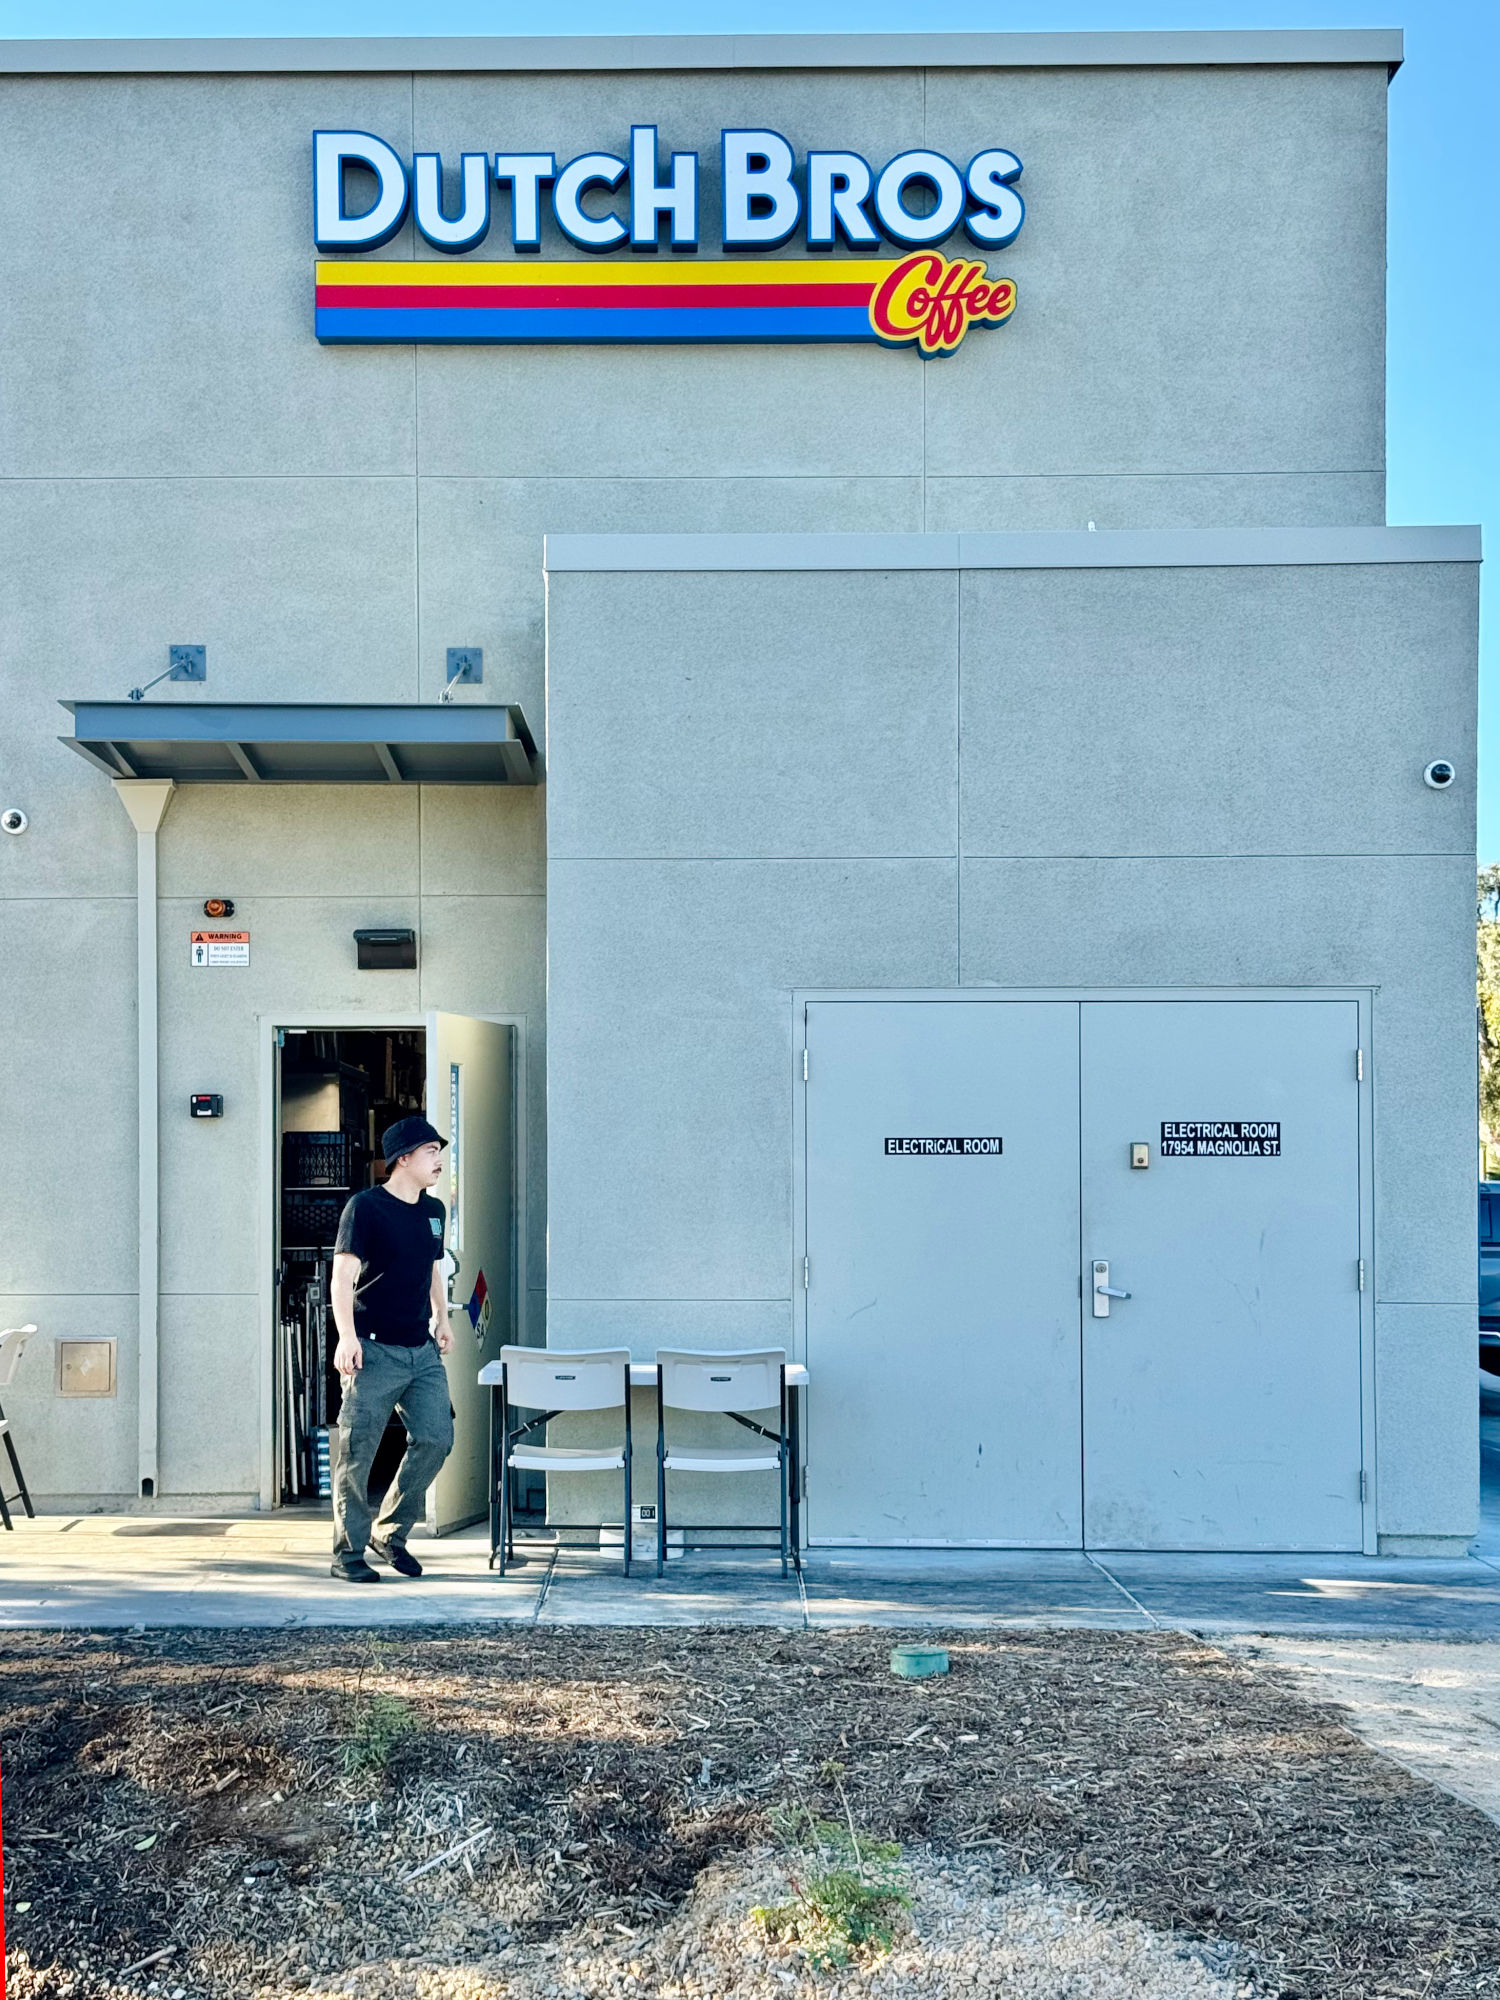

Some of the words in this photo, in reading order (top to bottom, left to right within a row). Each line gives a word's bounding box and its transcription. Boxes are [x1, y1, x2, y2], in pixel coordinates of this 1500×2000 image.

[721, 129, 1026, 252] BROS
[874, 255, 1012, 347] Coffee
[1164, 1123, 1238, 1138] ELECTRICAL
[1241, 1123, 1278, 1138] ROOM
[963, 1138, 1000, 1153] ROOM
[1162, 1140, 1195, 1155] 17954
[1197, 1140, 1261, 1155] MAGNOLIA
[1263, 1140, 1280, 1155] ST.
